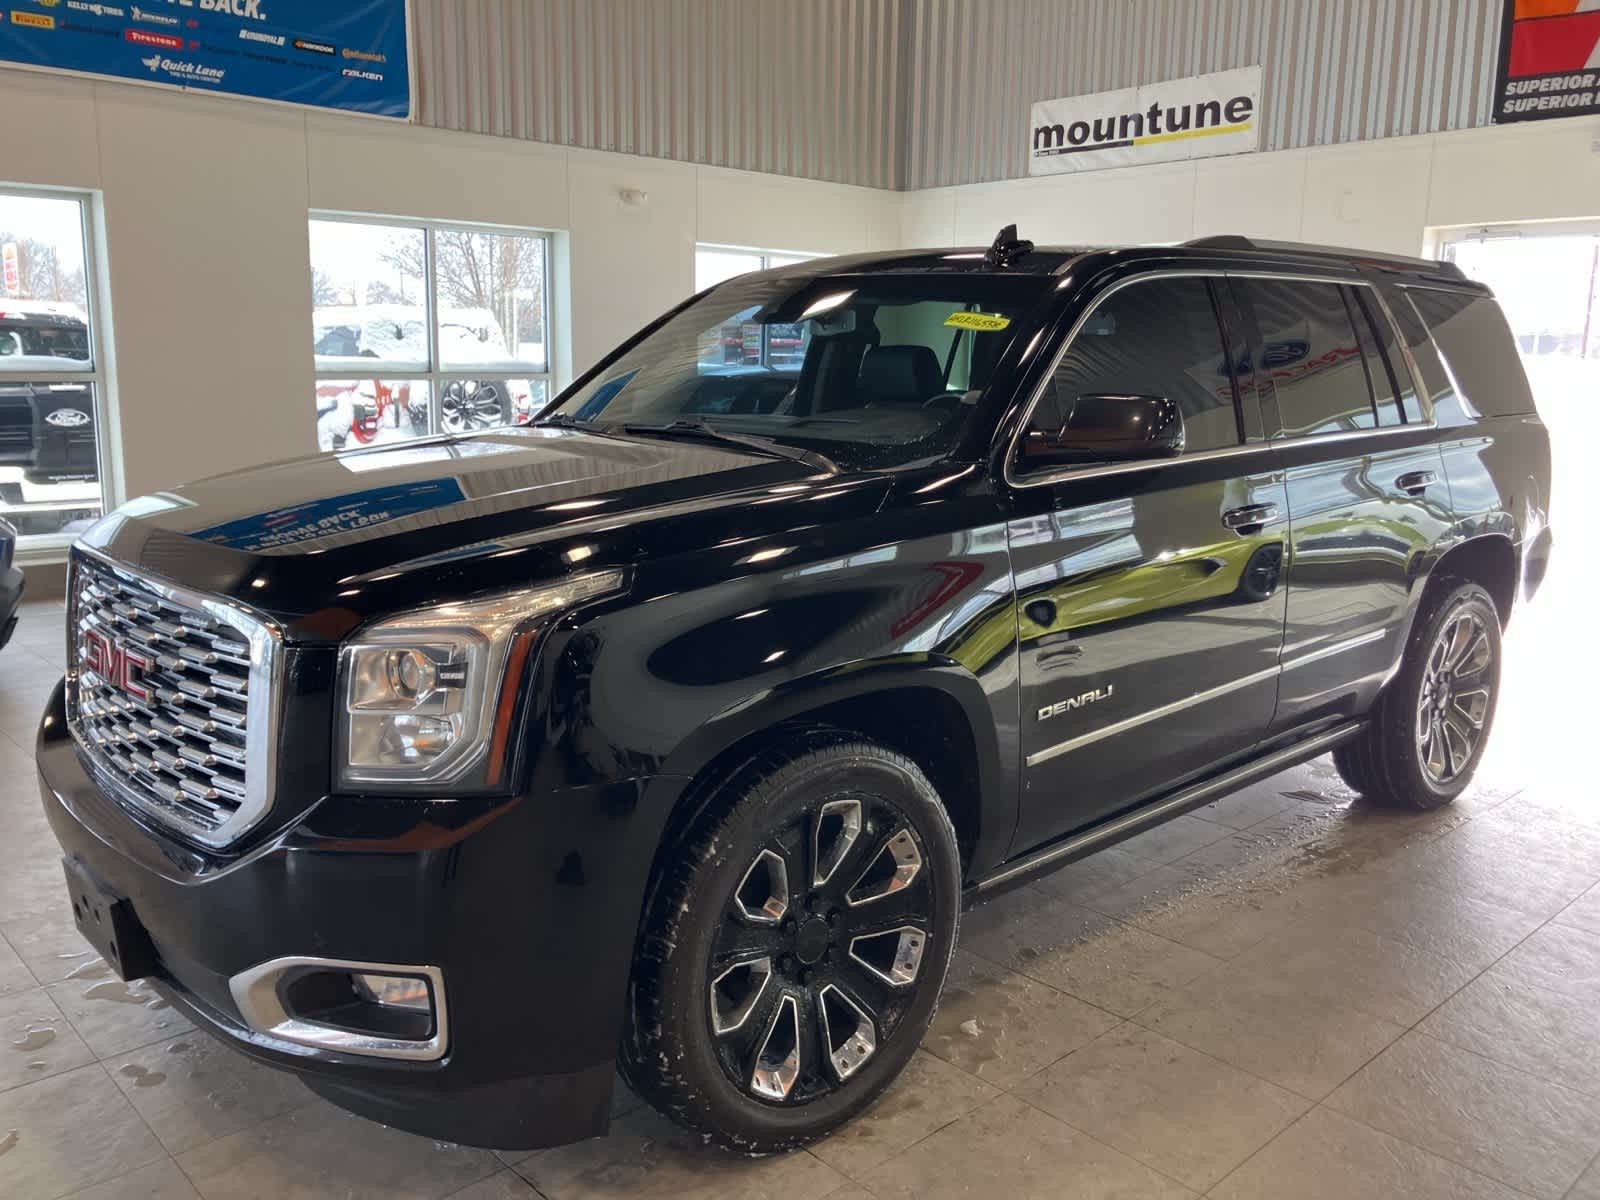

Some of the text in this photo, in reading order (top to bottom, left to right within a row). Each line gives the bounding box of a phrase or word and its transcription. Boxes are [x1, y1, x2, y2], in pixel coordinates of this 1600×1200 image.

[131, 31, 177, 46] Firestone
[161, 59, 225, 78] Quick Lane
[342, 68, 383, 81] FALKEN
[1505, 74, 1596, 96] SUPERIOR
[1503, 92, 1593, 113] SUPERIOR
[1033, 96, 1253, 149] mountune
[84, 629, 154, 704] GMC
[1037, 684, 1113, 720] DENALI
